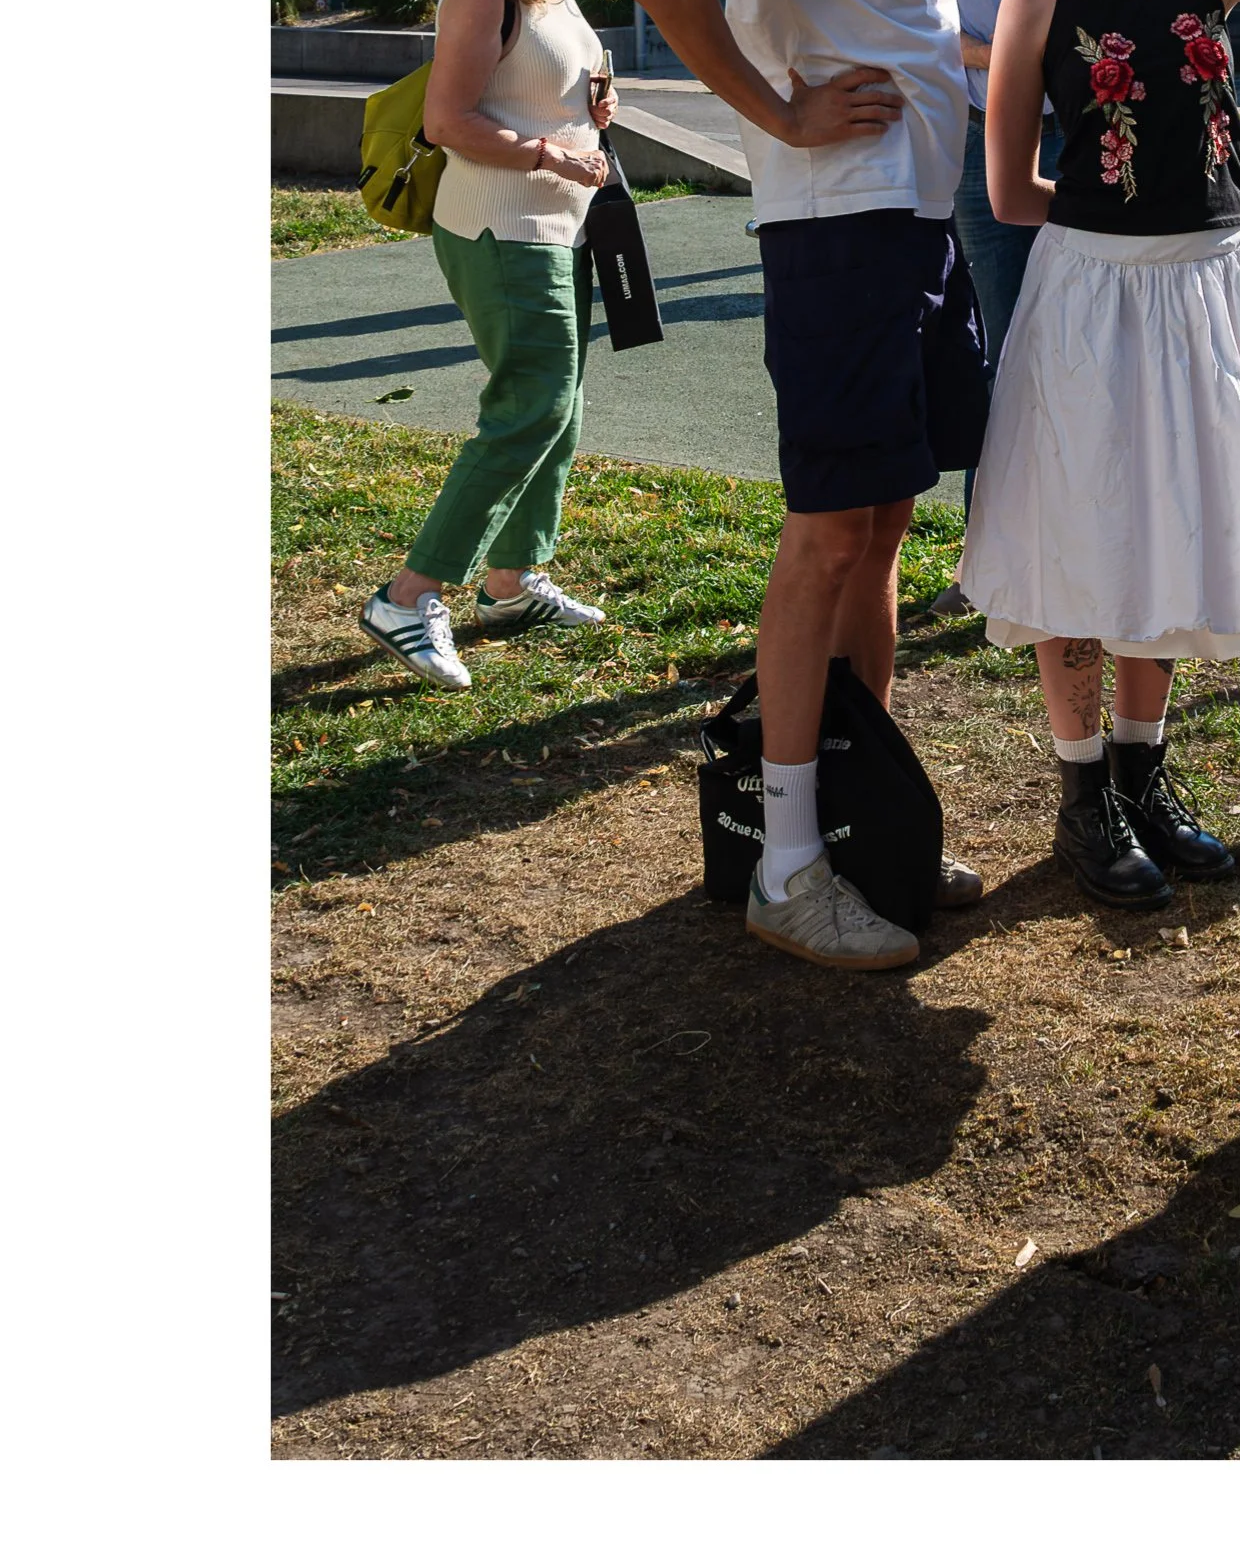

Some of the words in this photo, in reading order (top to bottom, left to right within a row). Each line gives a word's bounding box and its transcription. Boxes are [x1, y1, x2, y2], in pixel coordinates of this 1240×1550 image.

[616, 253, 632, 300] LUMAS.COM
[717, 811, 732, 828] 20
[729, 822, 752, 836] rue
